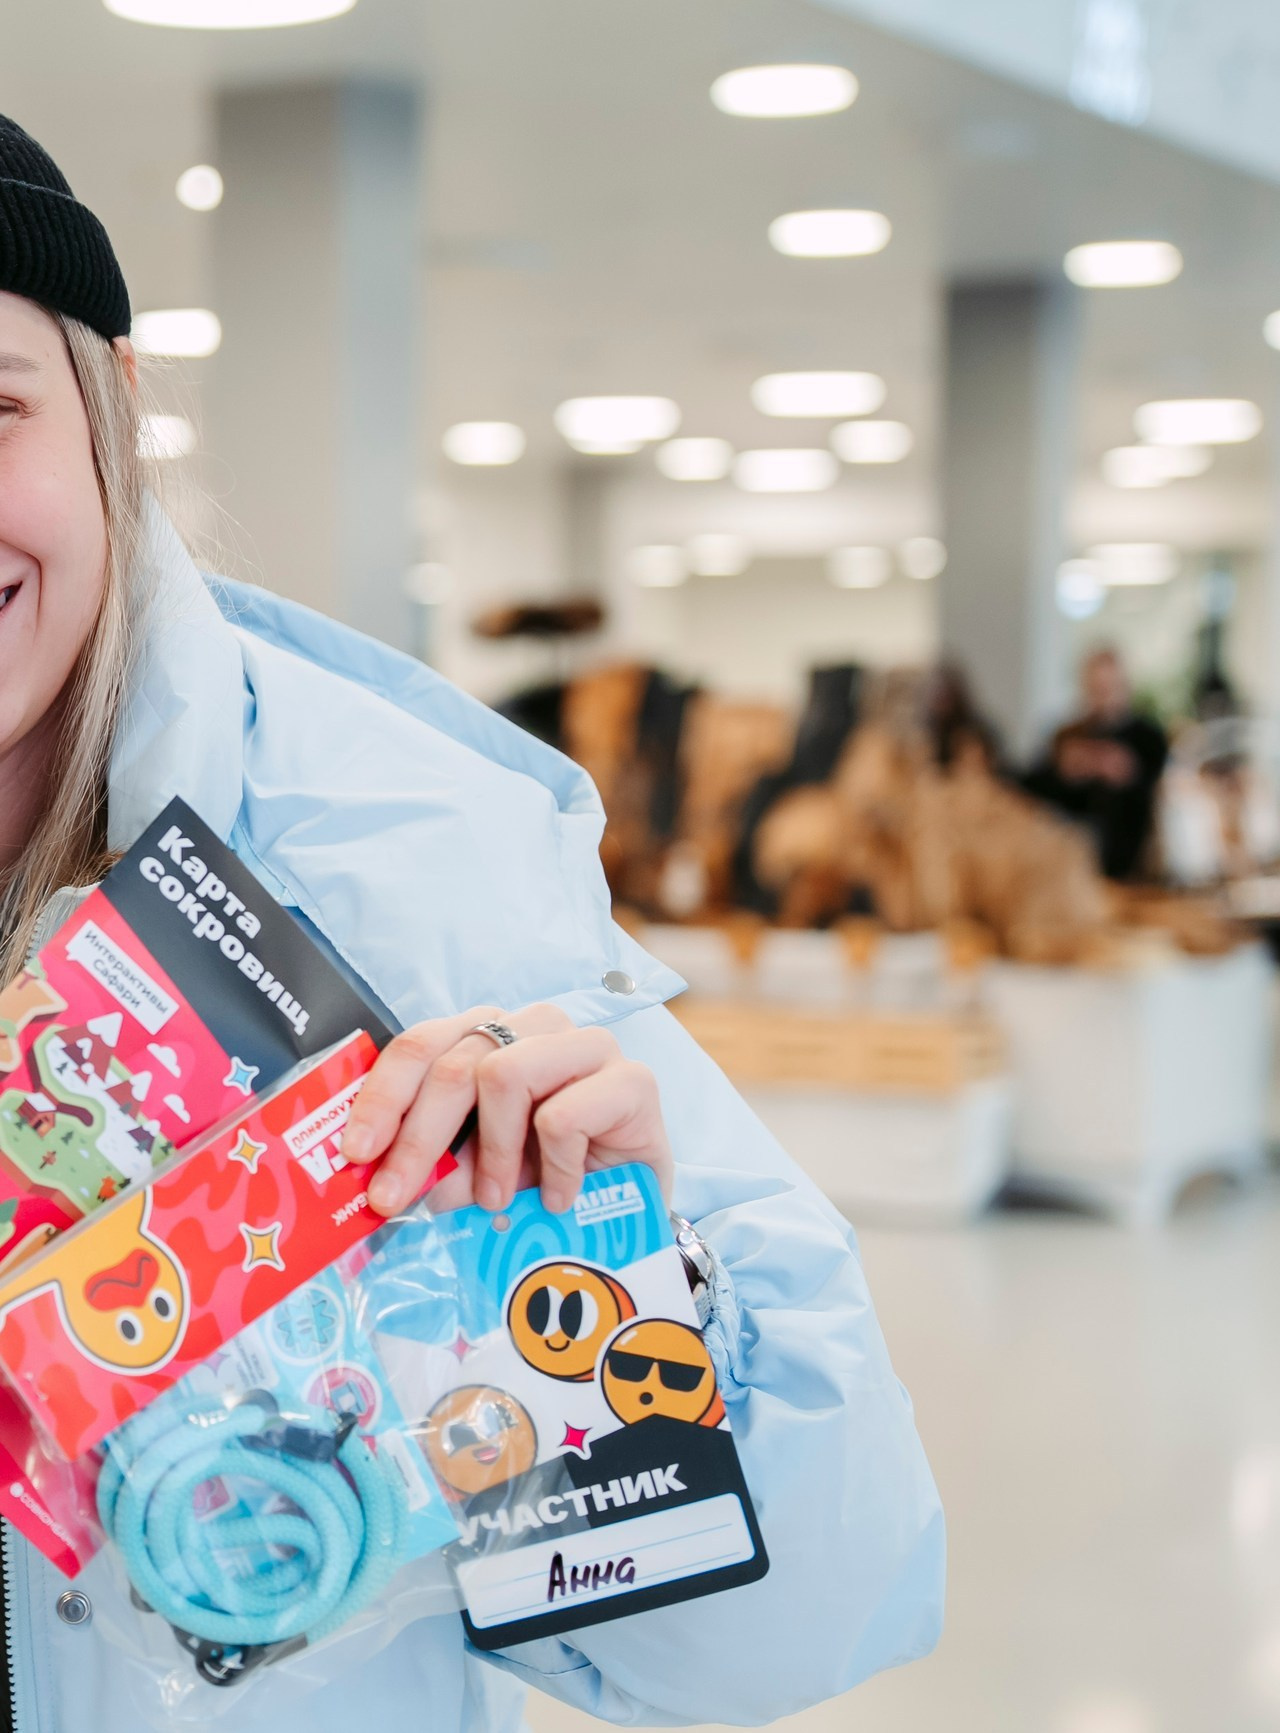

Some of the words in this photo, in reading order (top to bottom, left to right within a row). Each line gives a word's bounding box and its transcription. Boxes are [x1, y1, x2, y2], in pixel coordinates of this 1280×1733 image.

[157, 824, 262, 939] Карта
[84, 930, 169, 1014] Интерактивы
[138, 856, 311, 1037] сокровищ
[93, 958, 141, 1008] Сафари
[291, 1081, 365, 1150] ключений
[297, 1130, 352, 1185] ГА
[573, 1181, 643, 1213] ЛИГА
[457, 1463, 688, 1547] УЧАСТНИК
[547, 1551, 636, 1603] Анна
